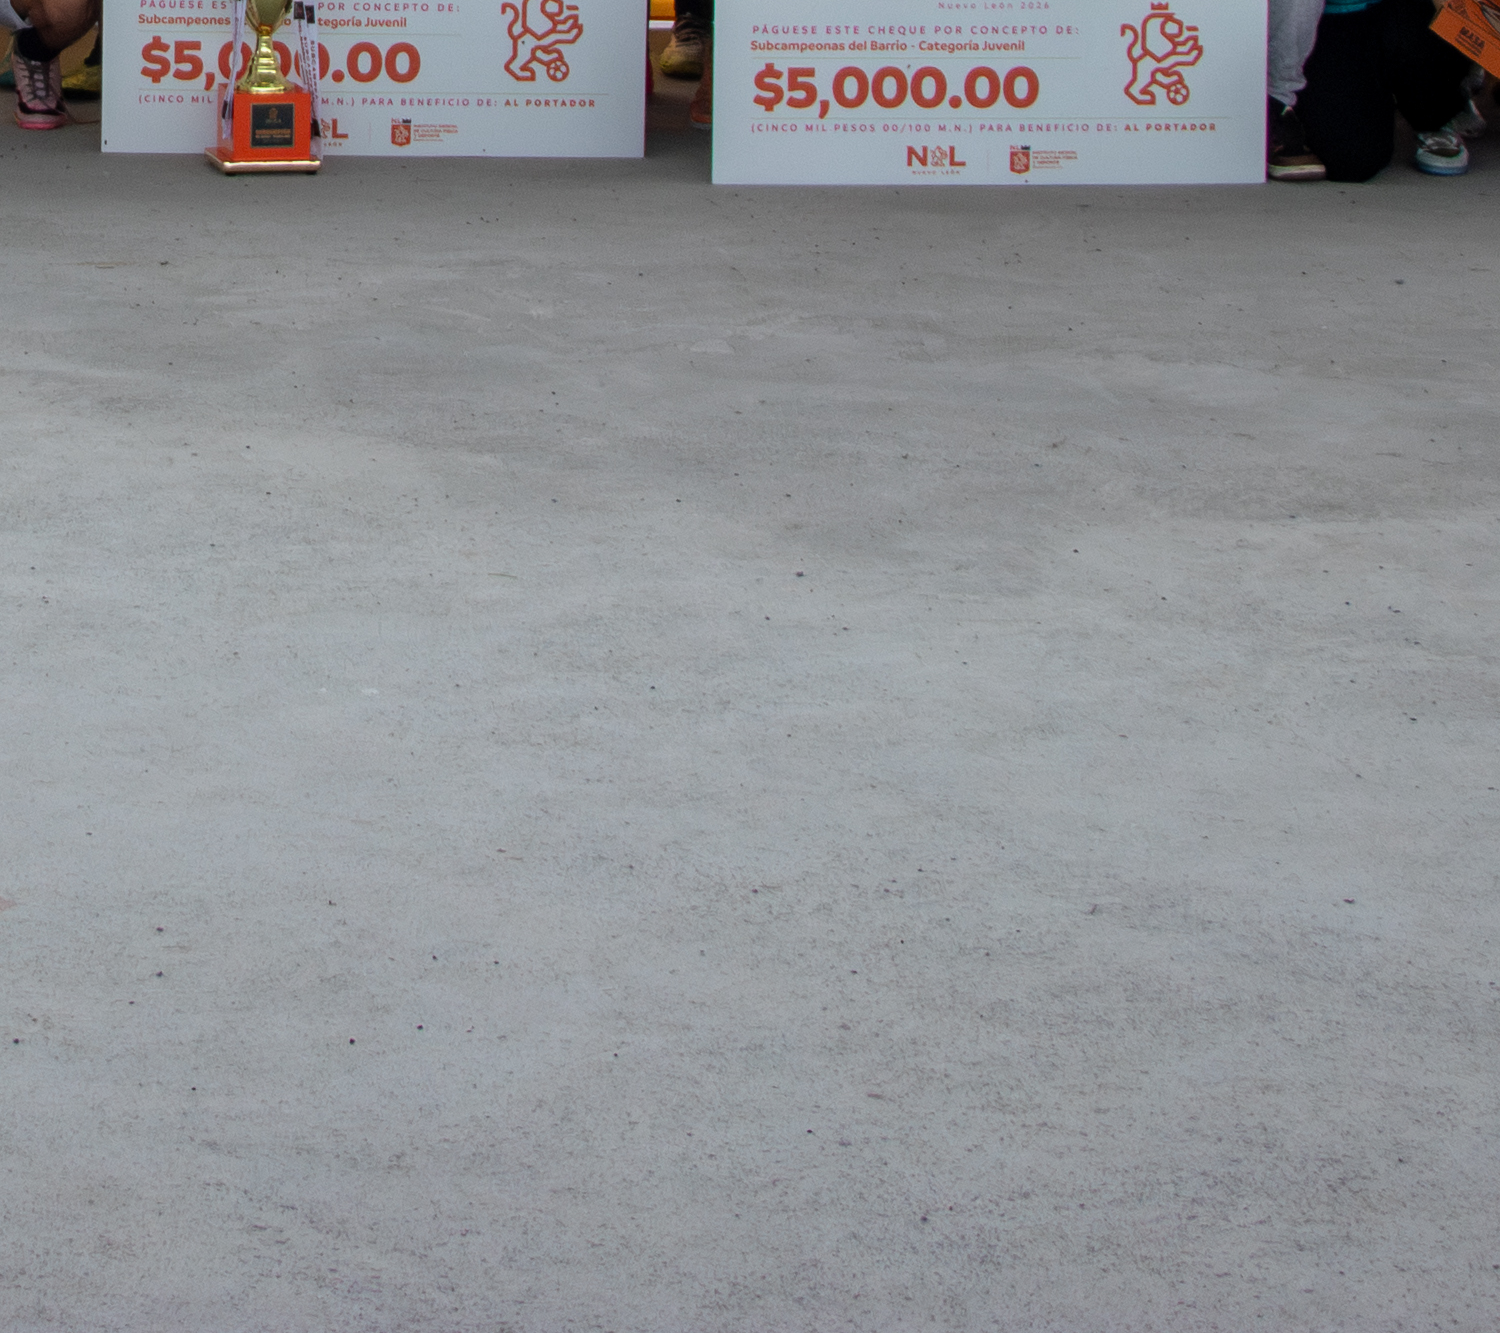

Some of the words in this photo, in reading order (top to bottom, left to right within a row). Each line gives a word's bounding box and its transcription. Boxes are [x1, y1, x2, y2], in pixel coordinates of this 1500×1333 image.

[317, 2, 345, 11] POR
[353, 3, 429, 12] CONCEPTO
[437, 3, 460, 12] DE:
[1021, 1, 1050, 10] 2026
[138, 14, 231, 26] Subcampeones
[317, 16, 362, 29] tegoría
[364, 16, 407, 28] Juvenil
[752, 24, 817, 34] PÁGUESE
[826, 25, 860, 34] ESTE
[868, 25, 926, 36] CHEQUE
[934, 25, 962, 34] POR
[971, 25, 1048, 35] CONCEPTO
[1056, 26, 1079, 35] DE:
[751, 40, 845, 53] Subcampeonas
[848, 40, 867, 51] del
[870, 40, 907, 51] Barrio
[919, 39, 979, 53] Categoría
[982, 40, 1025, 51] Juvenil
[753, 62, 1039, 119] $5,000.00
[191, 95, 214, 104] MIL
[362, 98, 394, 107] PARA
[401, 98, 470, 107] BENEFICIO
[477, 98, 498, 107] DE:
[504, 99, 519, 107] AL
[526, 99, 595, 108] PORTADOR
[751, 123, 797, 132] (CINCO
[835, 123, 876, 132] PESOS
[980, 123, 1013, 132] PARA
[1019, 123, 1090, 132] BENEFICIO
[1097, 123, 1118, 132] DE:
[1125, 123, 1139, 131] AL
[1146, 123, 1216, 131] PORTADOR
